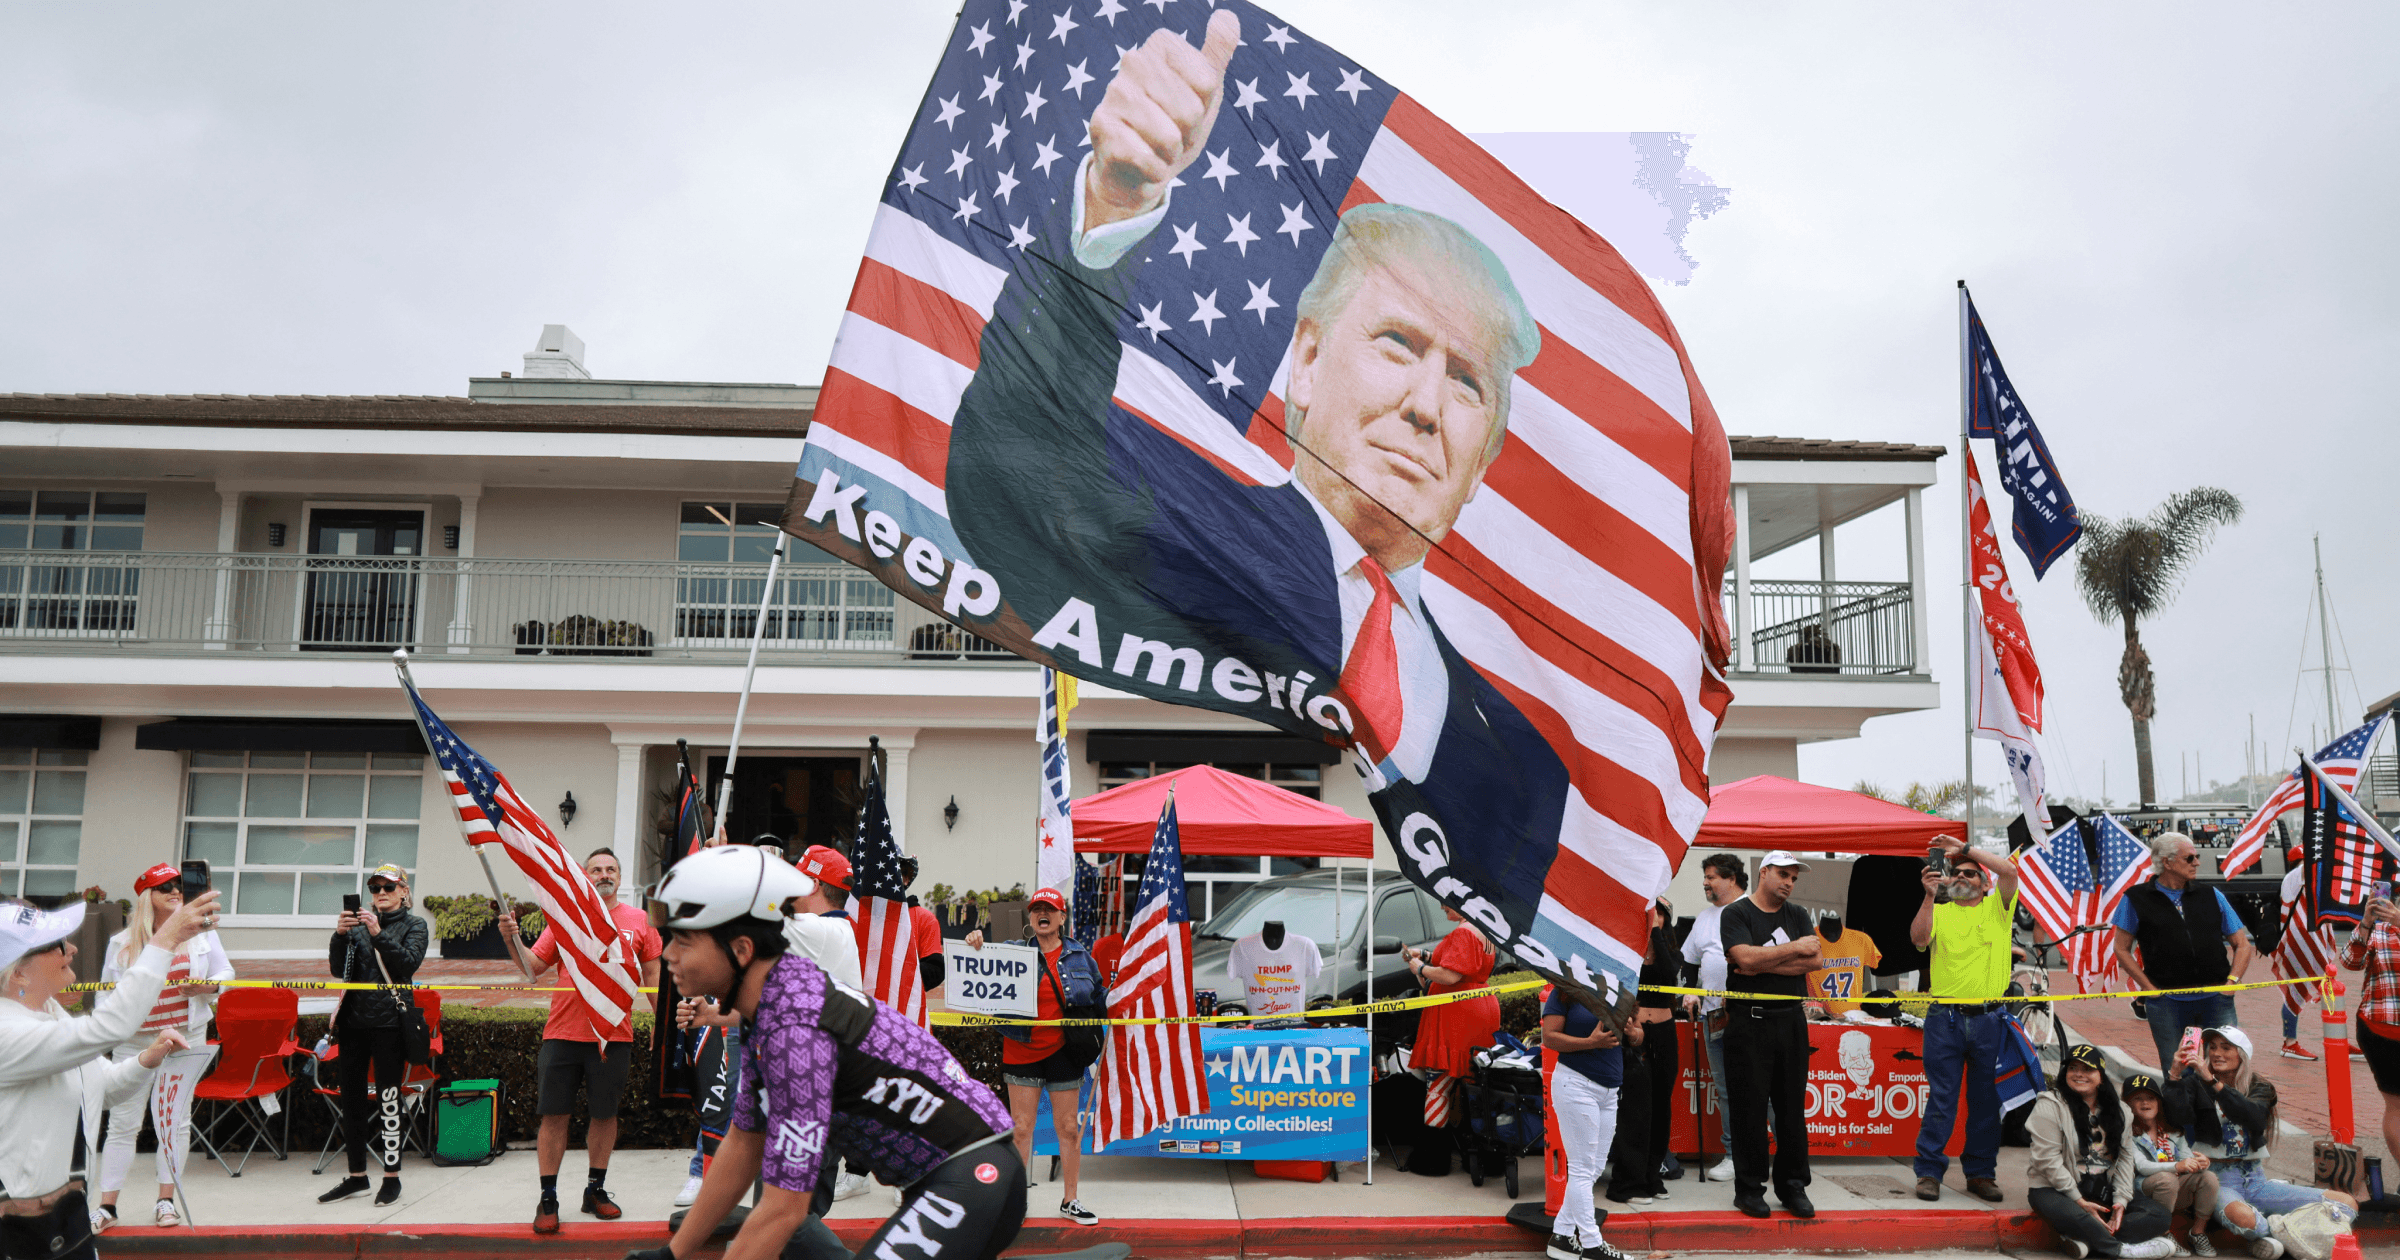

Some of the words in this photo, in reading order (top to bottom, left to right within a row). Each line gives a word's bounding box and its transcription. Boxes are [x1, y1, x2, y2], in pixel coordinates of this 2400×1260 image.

[2021, 485, 2057, 524] AGAIN!
[803, 467, 1001, 617] Keep
[1033, 891, 1059, 901] TRUMP
[953, 954, 1028, 978] TRUMP
[1257, 964, 1293, 975] TRUMP
[1821, 956, 1861, 969] UMPERS
[962, 979, 1018, 1001] 2024
[1821, 971, 1855, 999] 47
[2072, 1044, 2094, 1058] 47
[1230, 1045, 1361, 1085] MART
[1808, 1069, 1846, 1081] ti-Biden
[1888, 1071, 1928, 1083] Emporiu
[2131, 1075, 2150, 1088] 47
[1230, 1084, 1356, 1112] Superstore
[380, 1086, 401, 1166] adidas
[1180, 1115, 1231, 1135] Trump
[1234, 1115, 1333, 1132] Collectibles!
[1806, 1122, 1837, 1137] thing
[1838, 1122, 1847, 1135] is
[1848, 1122, 1866, 1134] for
[1866, 1122, 1893, 1135] Sale!
[1823, 1140, 1837, 1149] App
[1854, 1137, 1873, 1150] Pay
